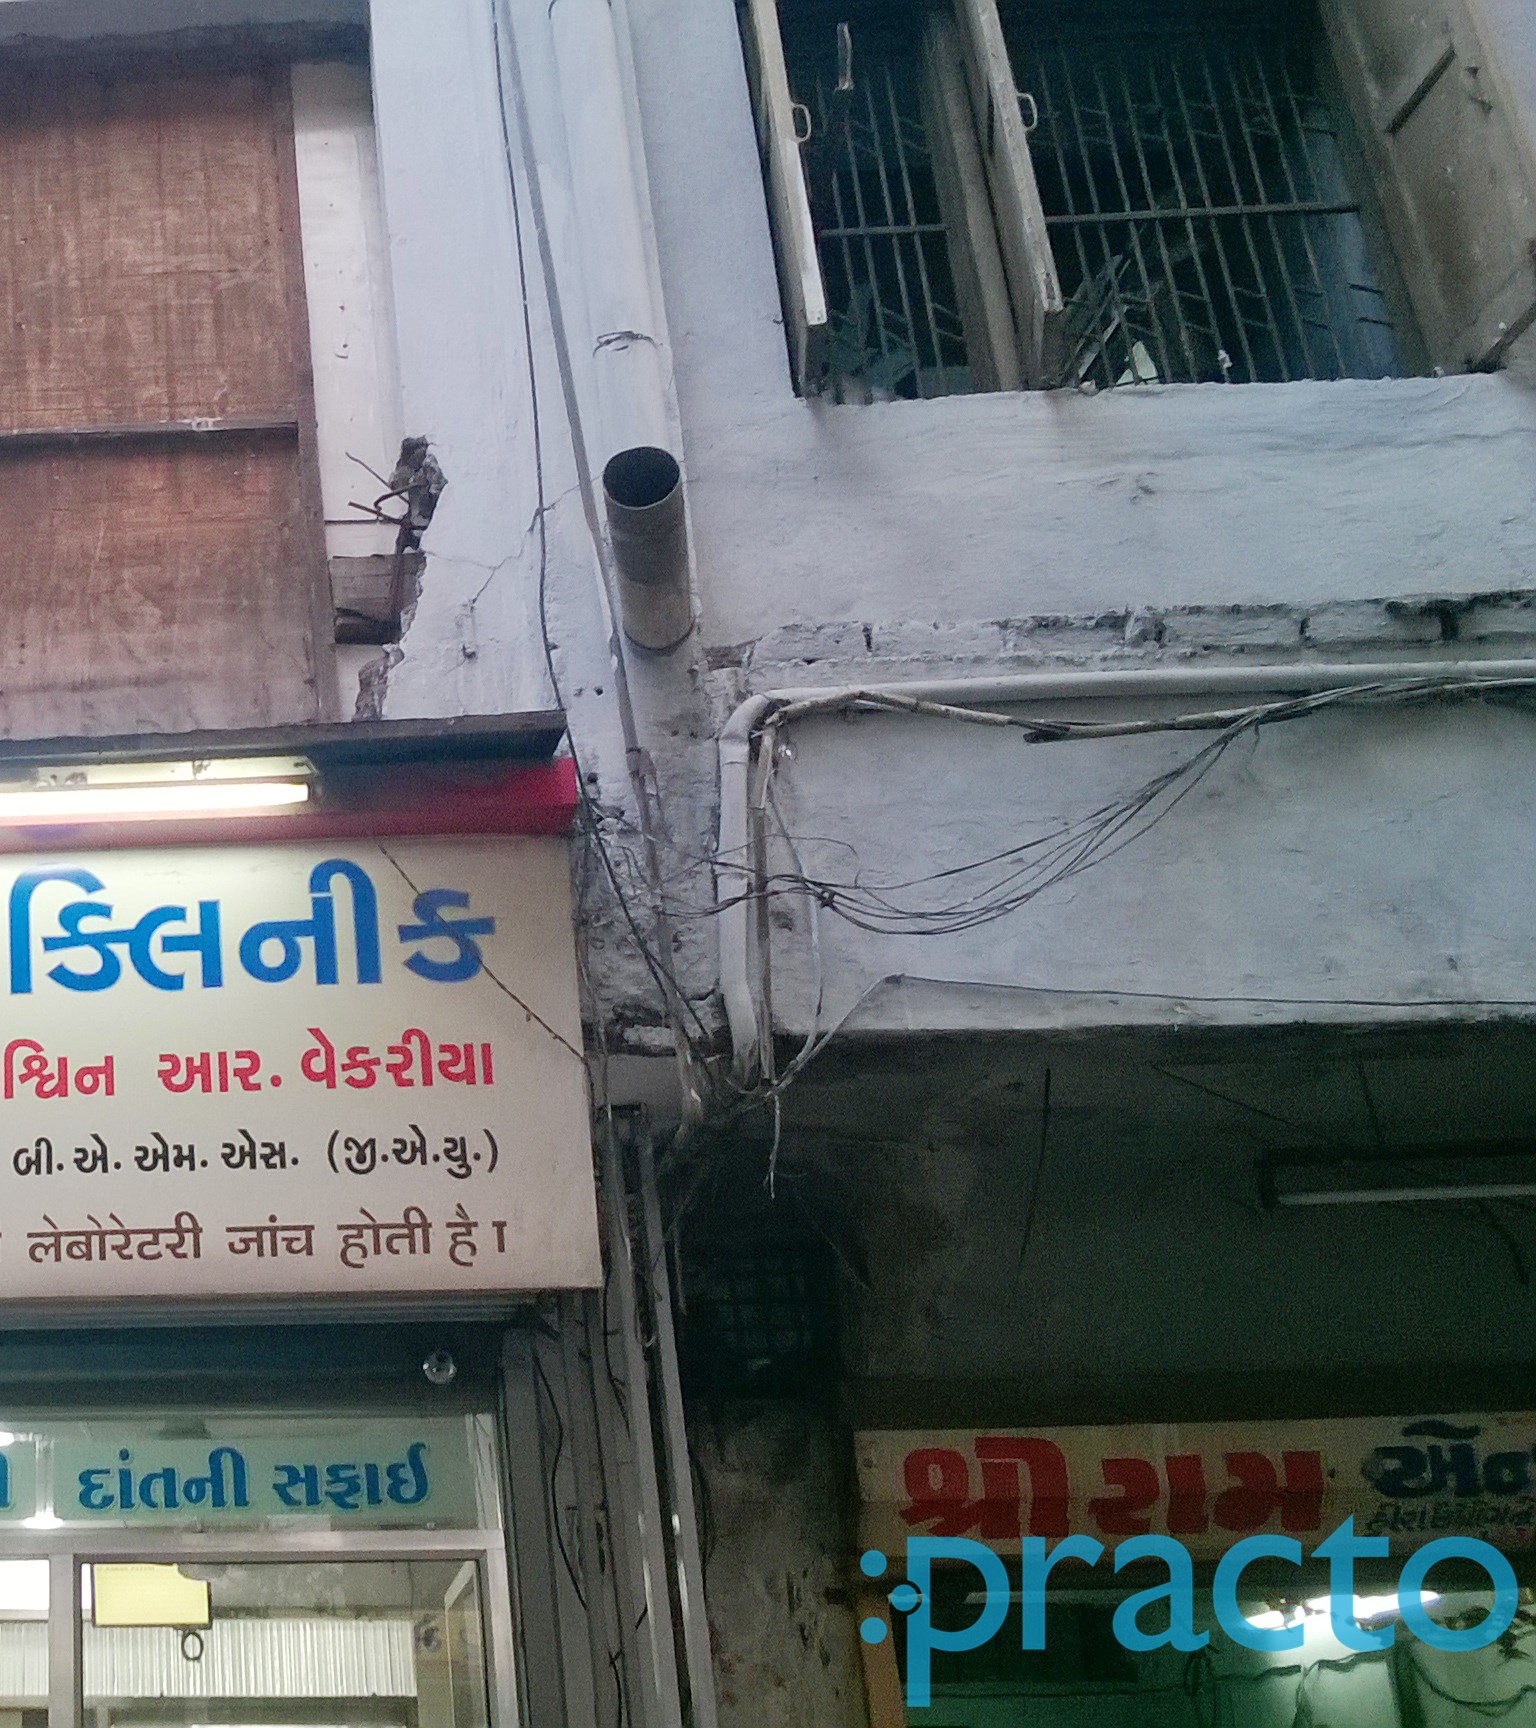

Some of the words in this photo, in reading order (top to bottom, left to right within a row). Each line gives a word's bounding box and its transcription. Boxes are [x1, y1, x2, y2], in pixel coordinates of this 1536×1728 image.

[6, 856, 498, 1000] ક્લિનીક
[158, 1050, 282, 1093] આર.
[301, 1028, 494, 1089] વેકરીયા
[27, 1211, 203, 1263] लेबोरेटरी
[226, 1215, 315, 1257] जांच
[337, 1206, 432, 1268] होती
[79, 1446, 252, 1512] દાંતની
[272, 1440, 429, 1510] સફાઈ
[898, 1435, 1070, 1540] શ્રી
[1086, 1449, 1326, 1535] રામ
